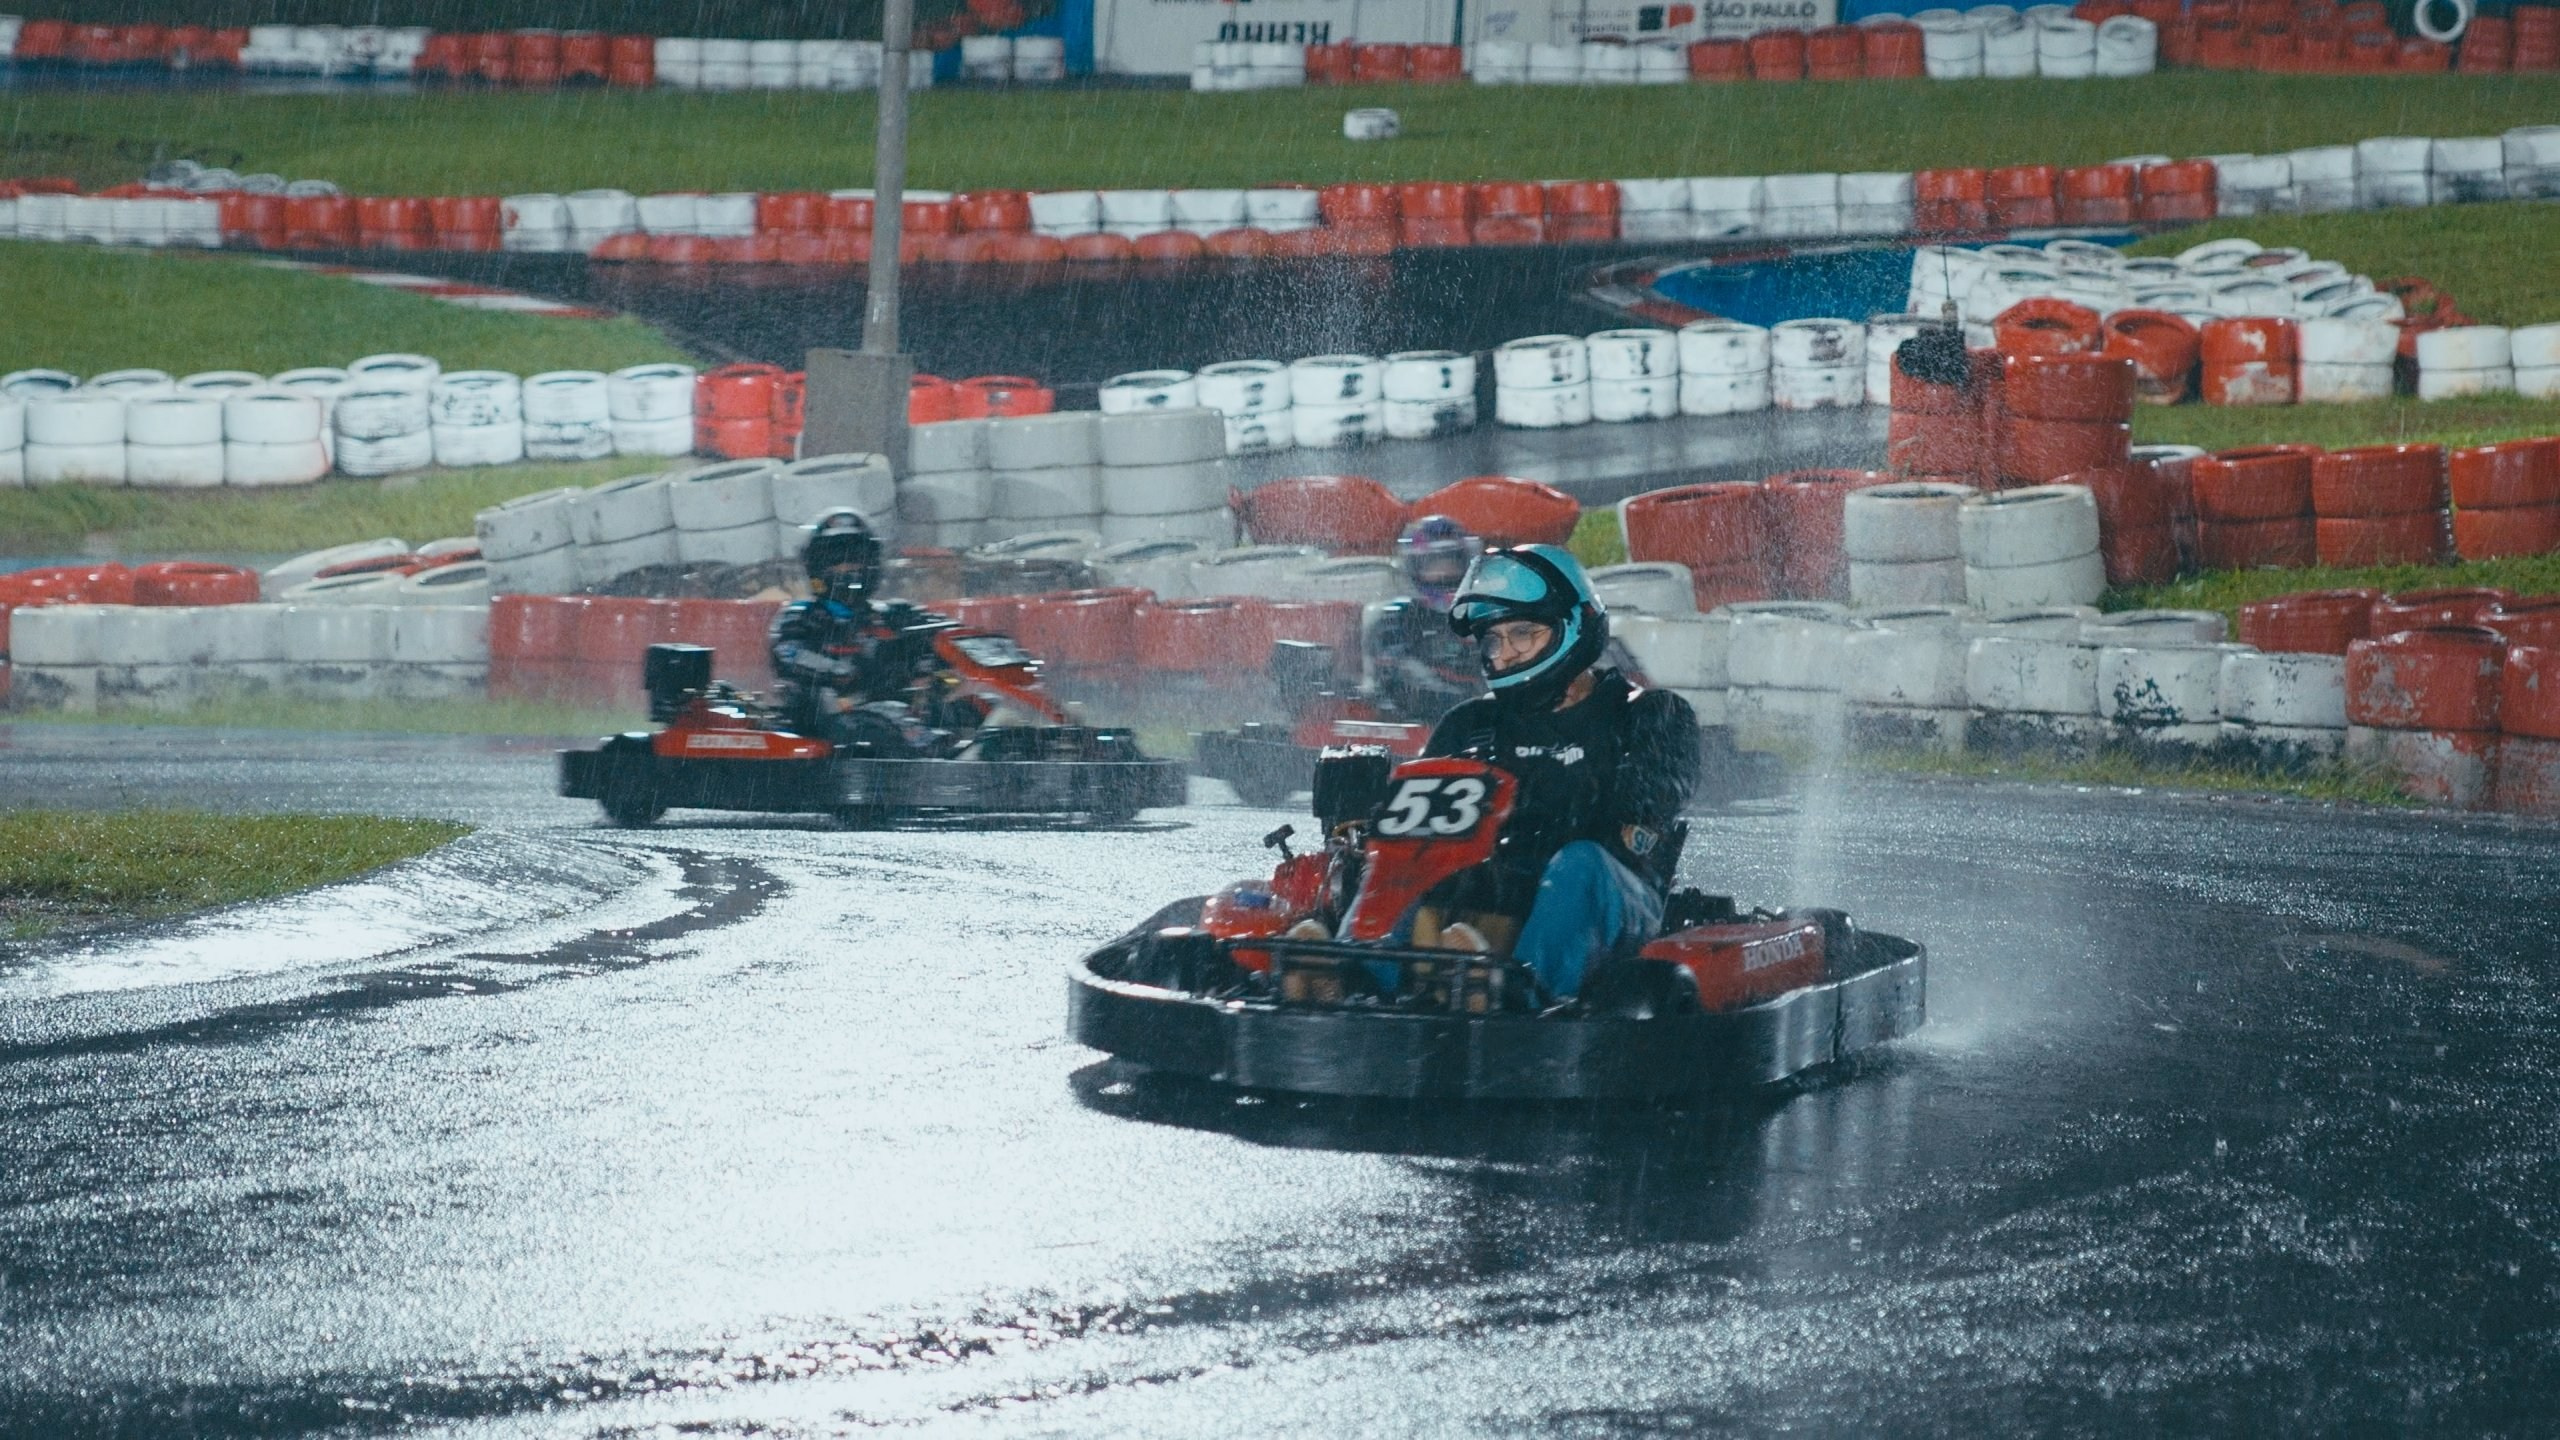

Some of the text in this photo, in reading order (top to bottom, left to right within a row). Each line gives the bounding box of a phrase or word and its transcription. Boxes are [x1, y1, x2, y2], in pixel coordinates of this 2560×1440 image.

[1704, 1, 1817, 18] SÃO PAULO
[1378, 778, 1486, 835] 53
[1742, 934, 1804, 971] HONDA
